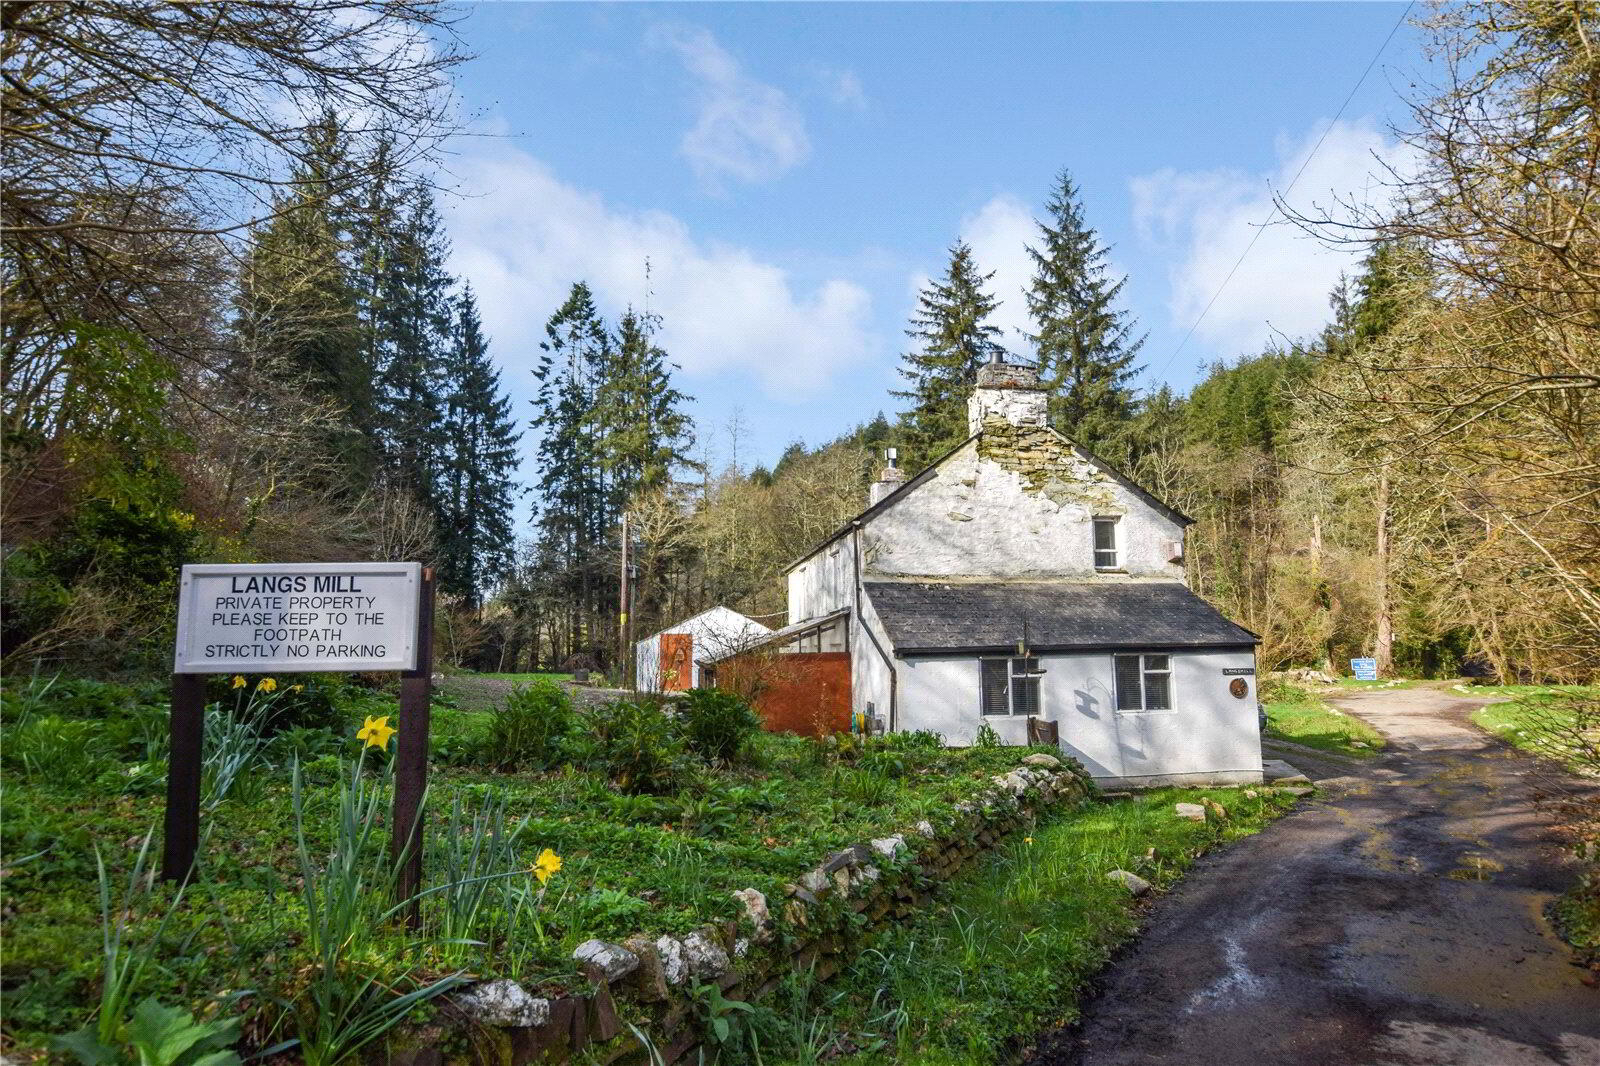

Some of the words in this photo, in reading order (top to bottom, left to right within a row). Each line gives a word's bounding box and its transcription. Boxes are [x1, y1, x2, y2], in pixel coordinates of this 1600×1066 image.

[231, 577, 307, 594] LANGS
[313, 576, 362, 593] MILL
[215, 597, 282, 609] PRIVATE
[289, 597, 376, 609] PROPERTY
[211, 613, 272, 626] PLEASE
[278, 613, 319, 625] KEEP
[326, 613, 348, 625] TO
[354, 613, 385, 625] THE
[254, 629, 342, 641] FOOTPATH
[205, 645, 280, 658] STRICTLY
[286, 645, 309, 657] NO
[316, 645, 386, 658] PARKING
